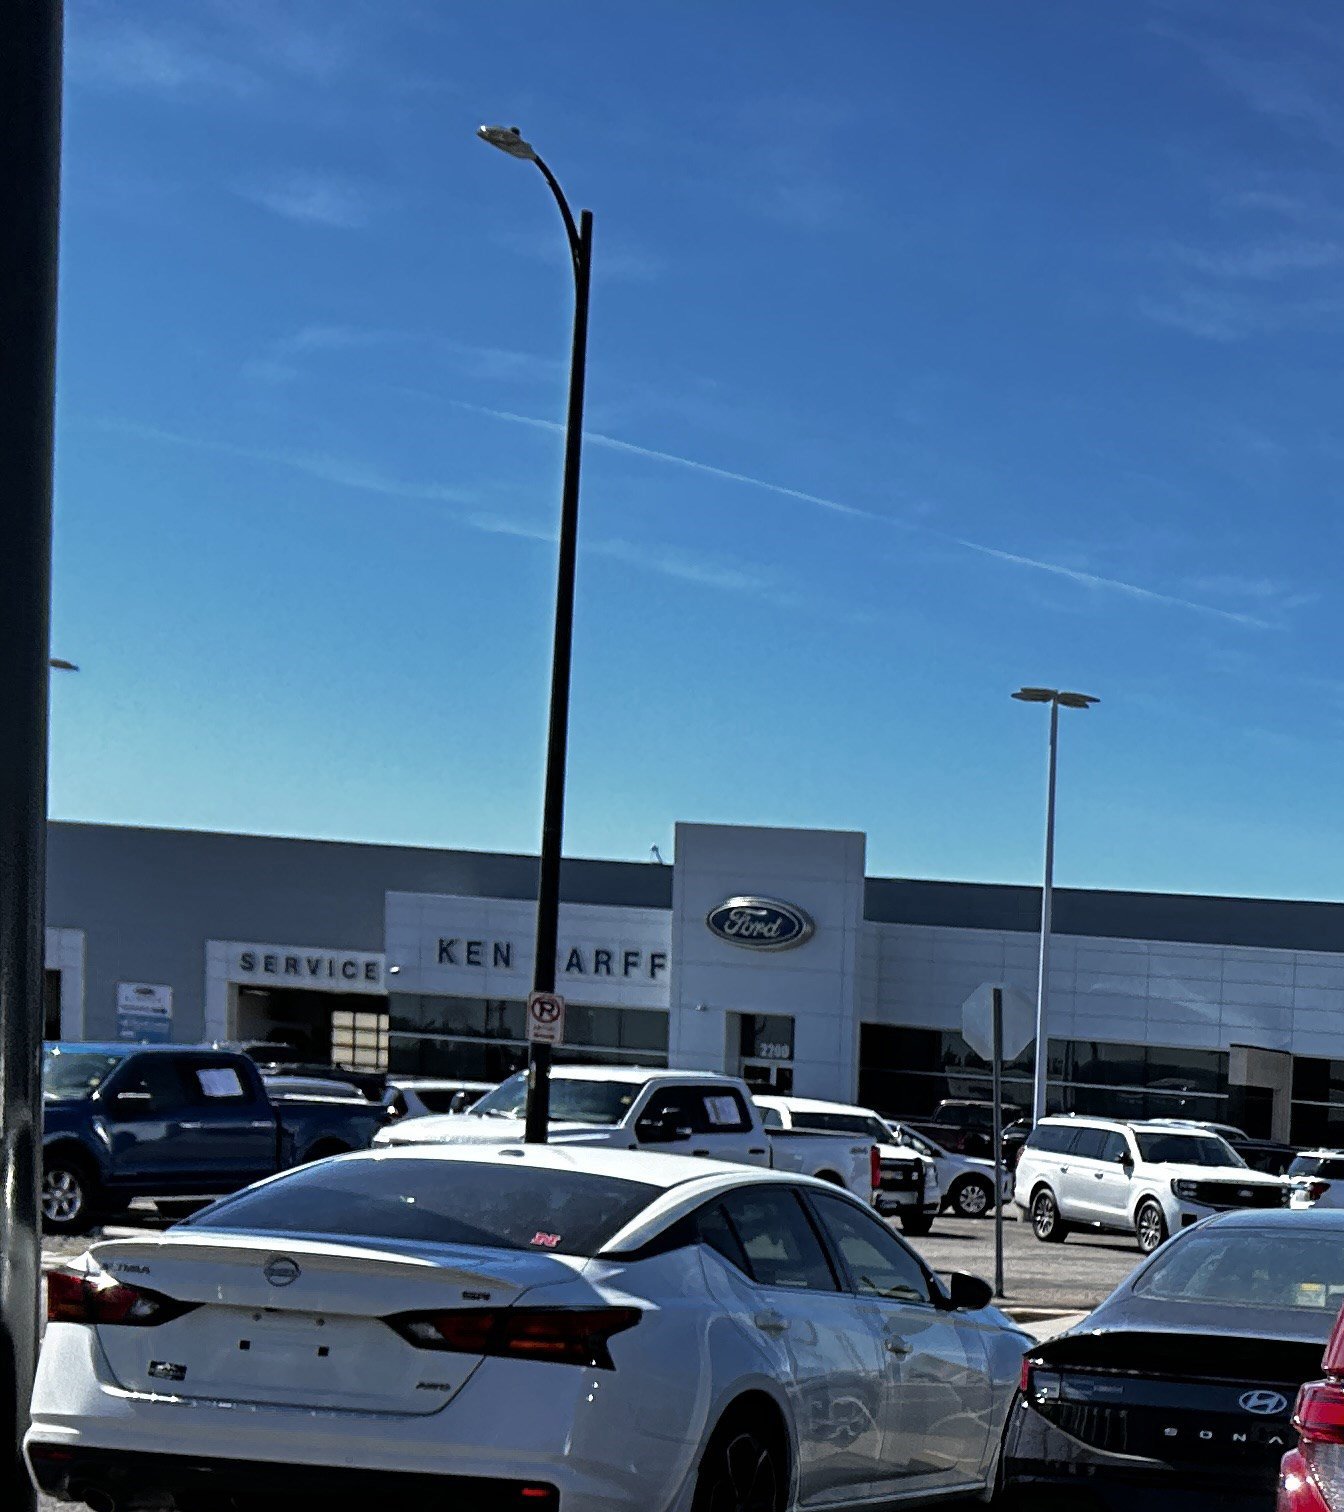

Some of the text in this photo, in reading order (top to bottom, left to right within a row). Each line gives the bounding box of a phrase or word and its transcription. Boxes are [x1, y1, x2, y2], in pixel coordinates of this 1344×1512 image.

[724, 908, 782, 937] Ford
[240, 952, 378, 981] SERVICE
[437, 938, 668, 979] KEN ARFF
[1164, 1427, 1284, 1444] SONA
